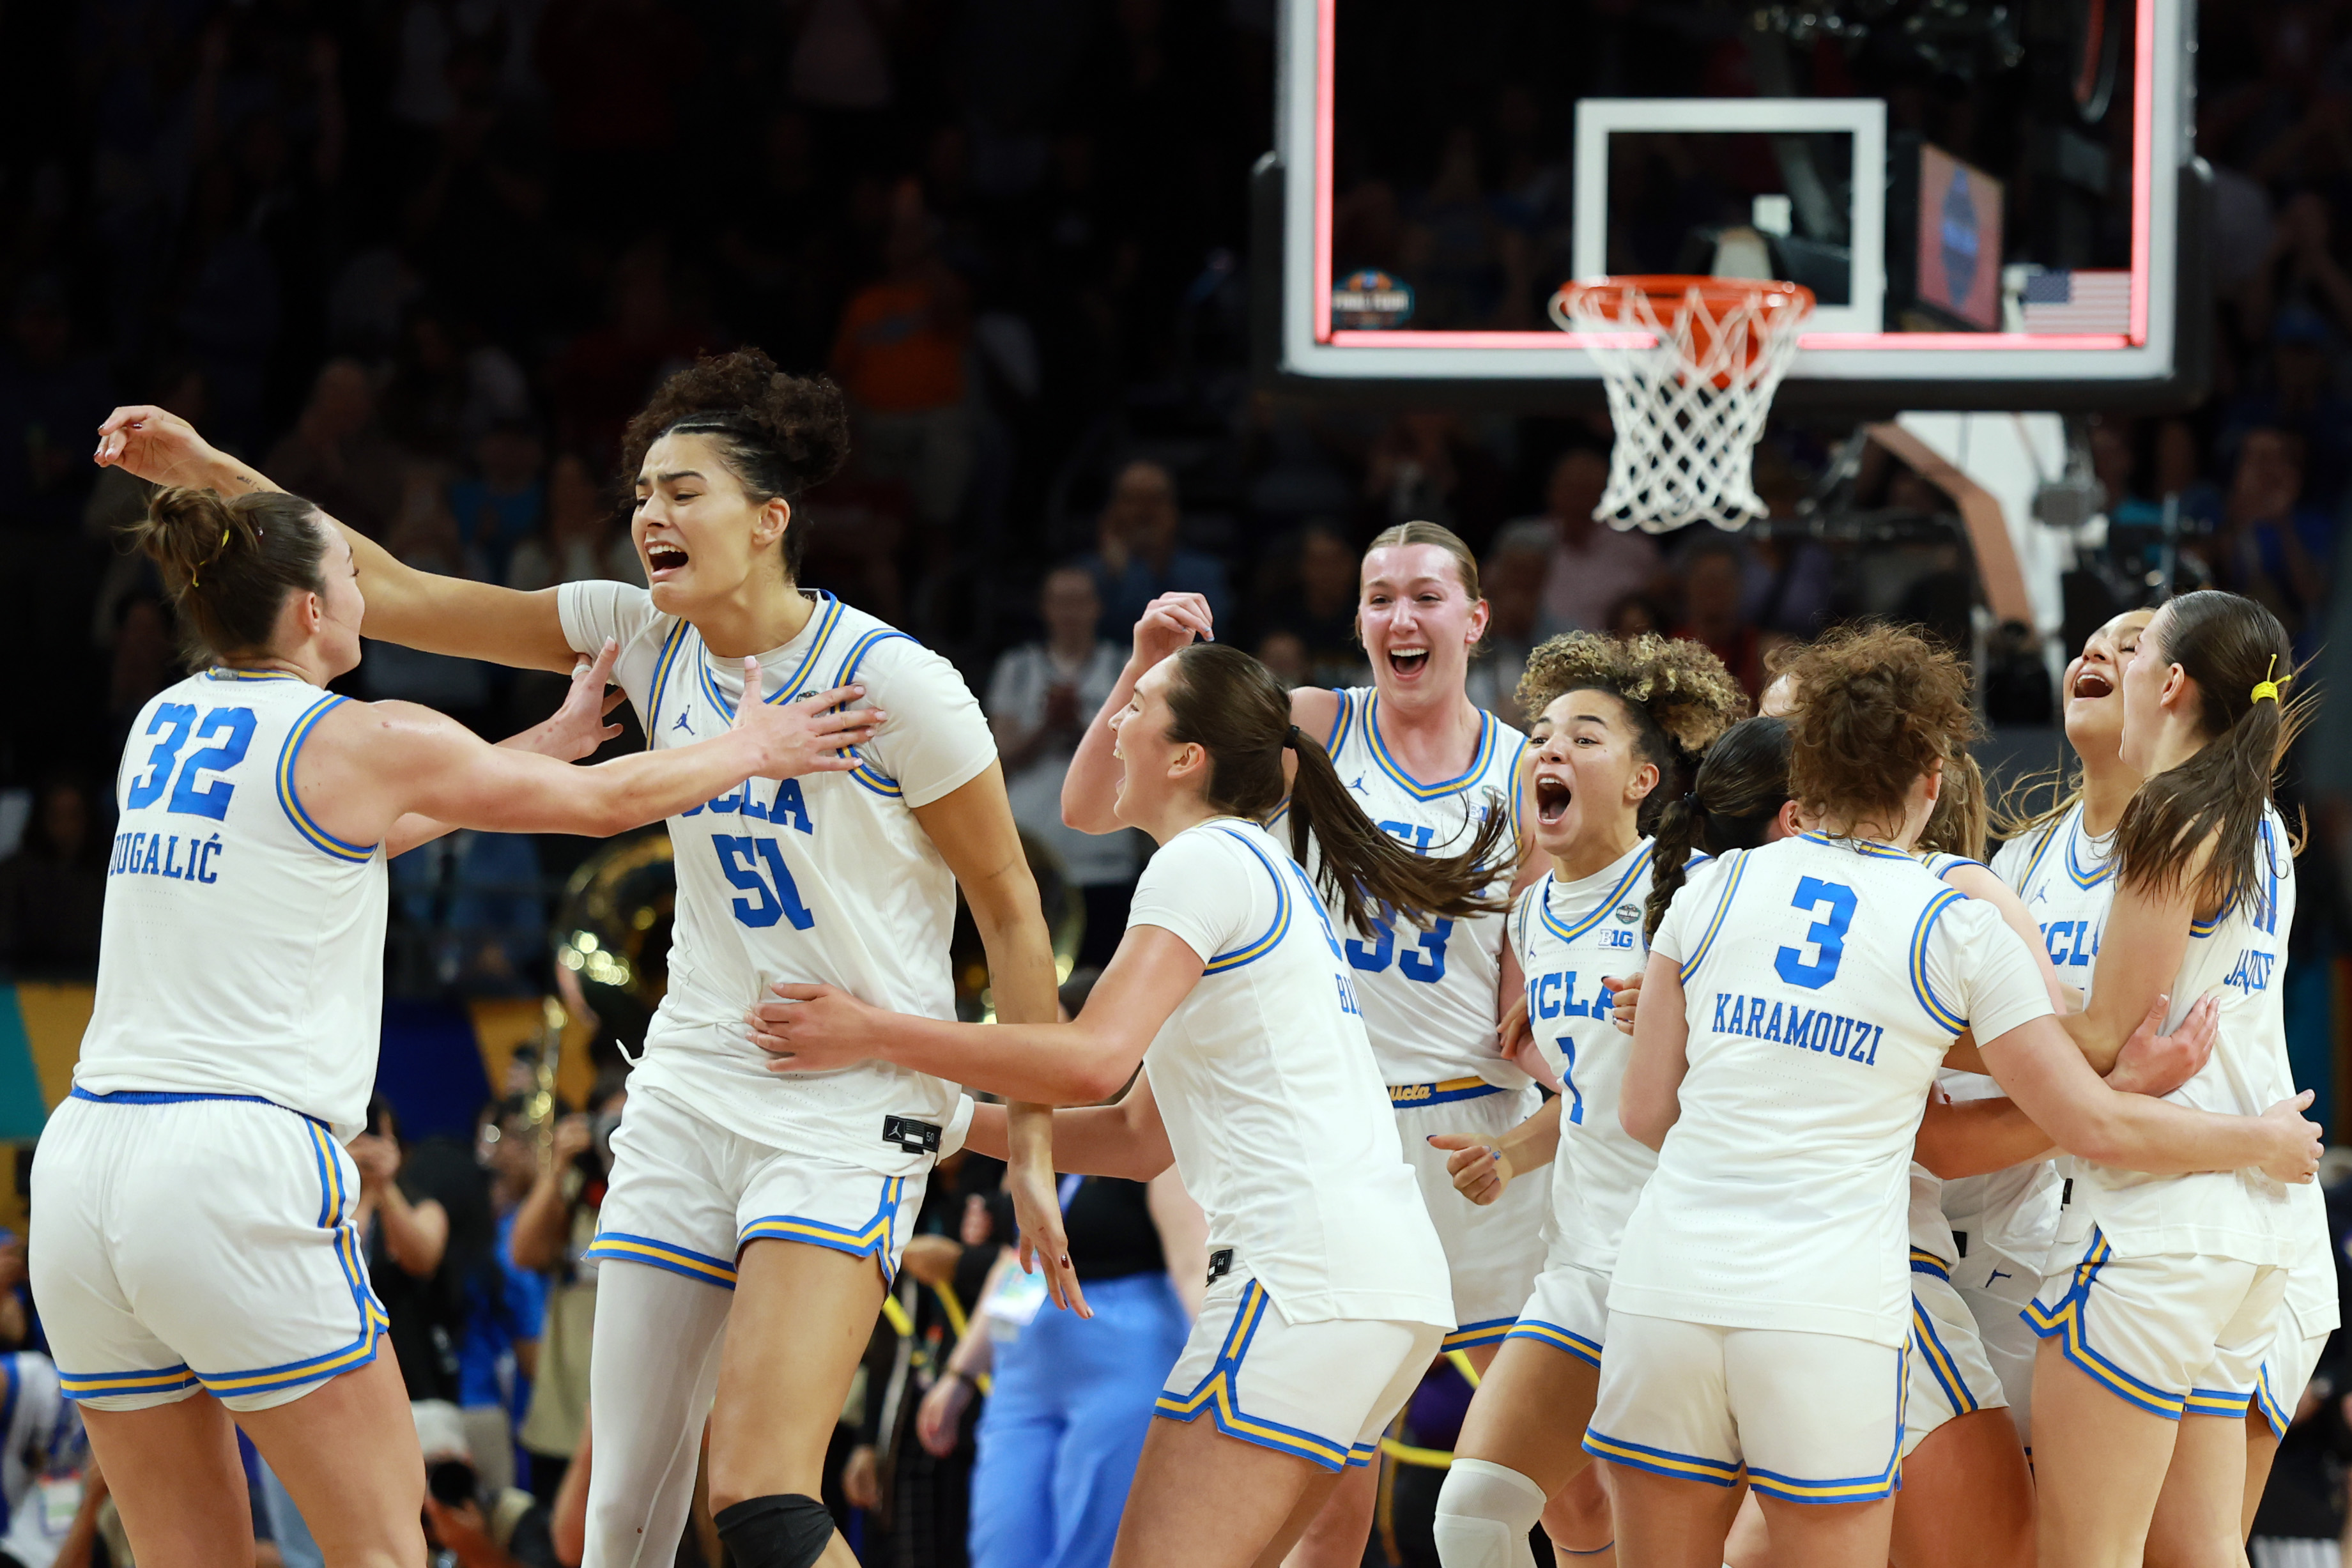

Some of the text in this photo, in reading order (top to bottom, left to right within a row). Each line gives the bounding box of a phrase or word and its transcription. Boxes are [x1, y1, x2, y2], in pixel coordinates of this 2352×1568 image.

[127, 702, 257, 821] 32
[711, 834, 815, 931] 51
[1774, 875, 1858, 990] 3
[1712, 993, 1884, 1066] KARAMOUZI
[1556, 1036, 1584, 1126] 1
